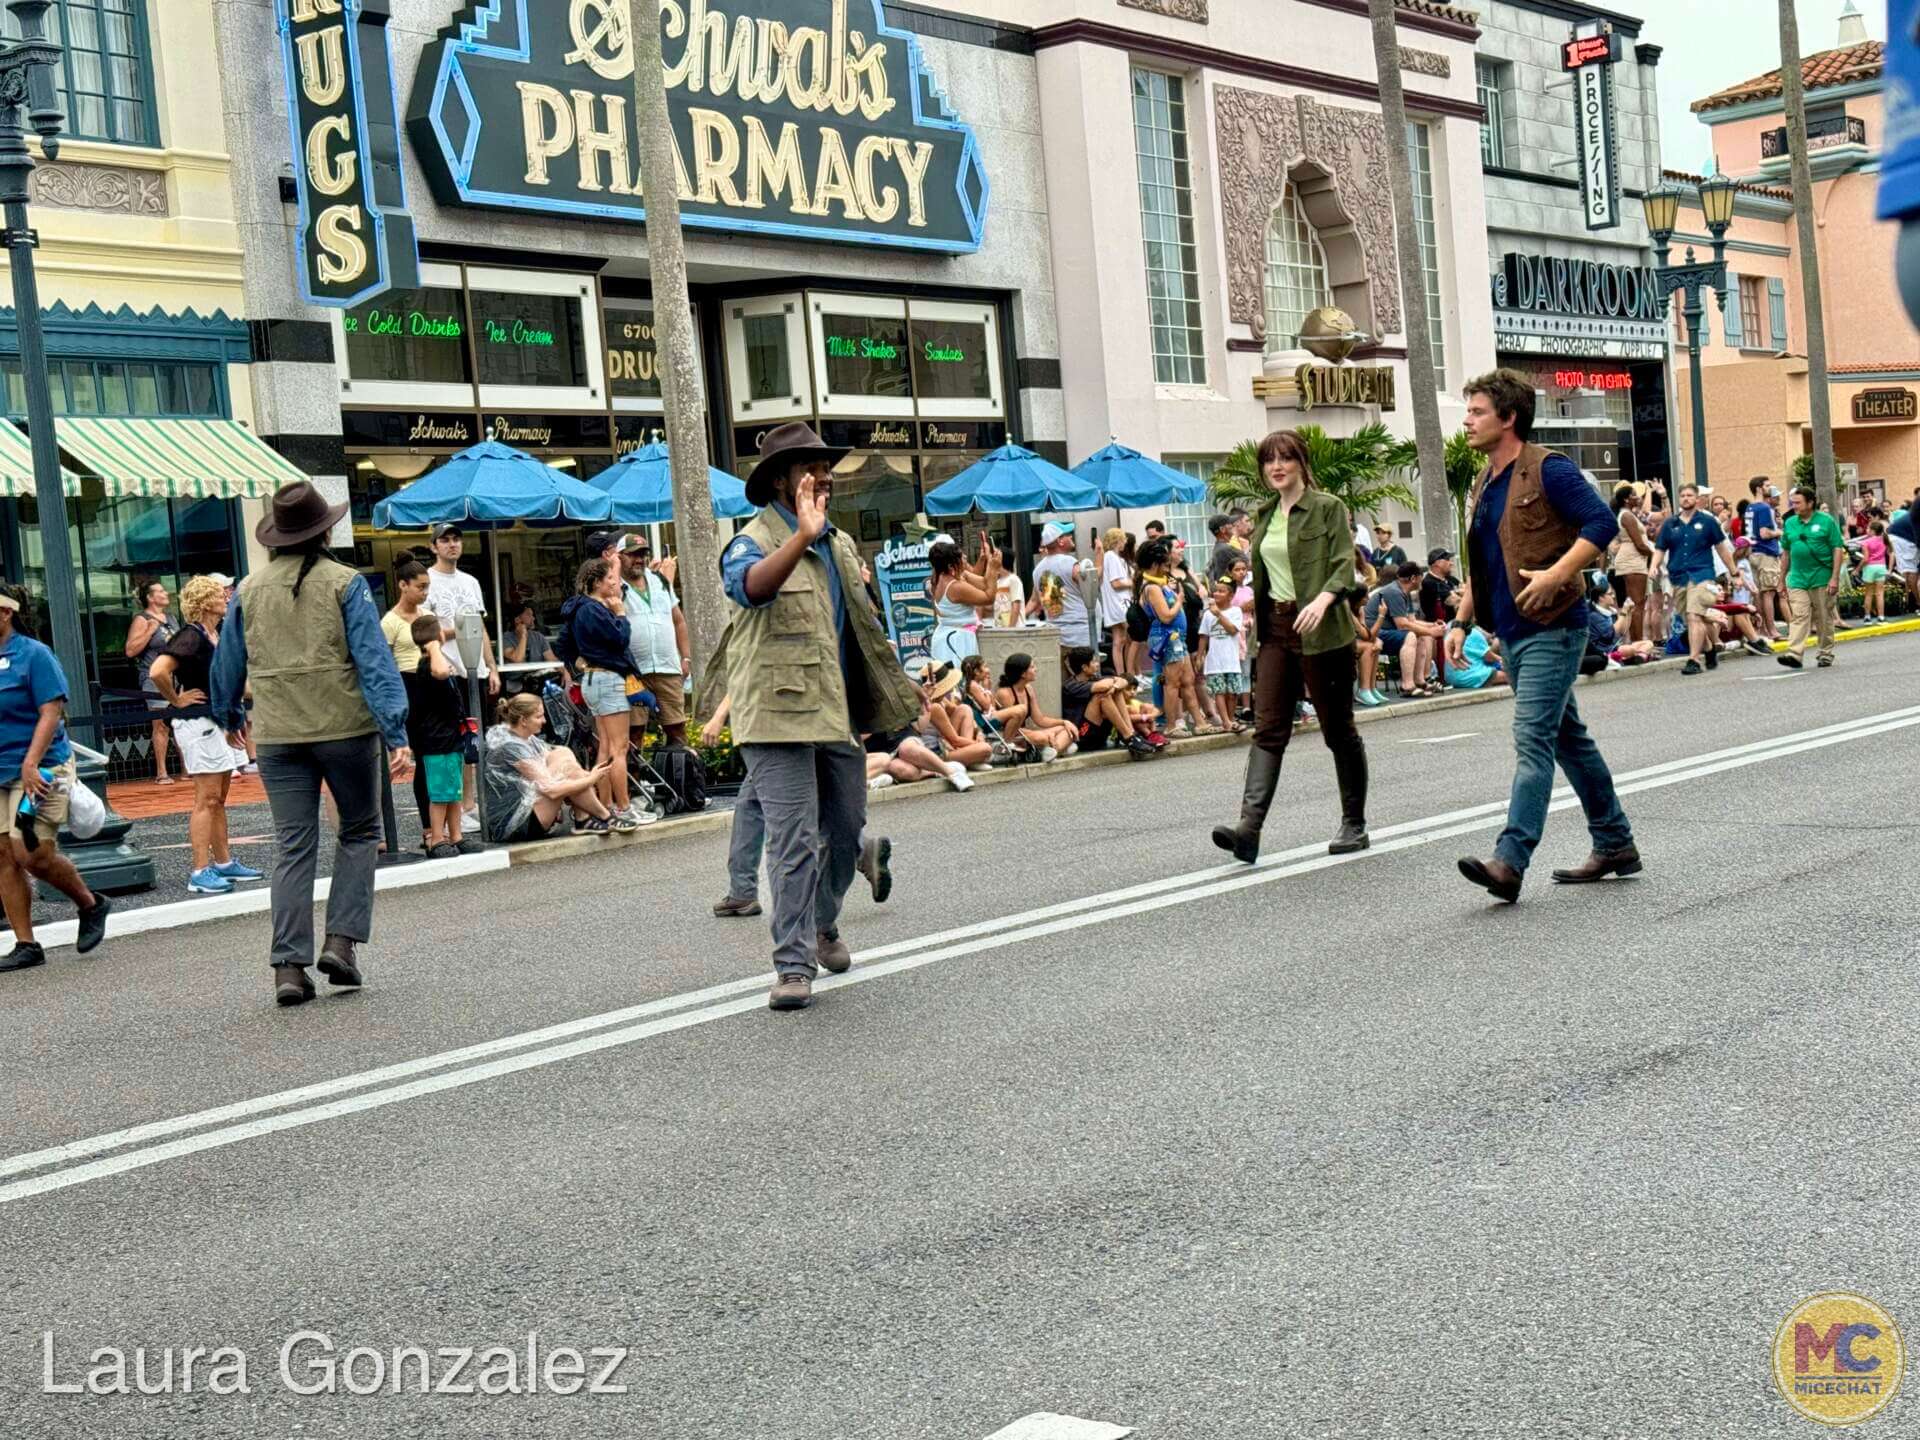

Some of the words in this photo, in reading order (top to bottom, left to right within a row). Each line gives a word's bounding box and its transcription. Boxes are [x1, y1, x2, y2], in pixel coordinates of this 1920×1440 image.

[565, 0, 895, 120] Schwab's
[1585, 72, 1606, 216] PROCESSING
[1514, 252, 1663, 320] DARKROOM
[368, 310, 403, 335] Cold
[409, 311, 461, 338] Drinks
[486, 320, 507, 342] Ice
[512, 319, 554, 345] Cream
[827, 336, 857, 358] Milk
[860, 337, 897, 359] Shakes
[924, 341, 965, 362] Sundaes
[1541, 335, 1608, 357] PHOTOGRAPHIC
[1555, 371, 1584, 387] PHOTO
[1589, 372, 1633, 388] FINISHING
[1856, 396, 1914, 418] THEATER
[408, 415, 469, 441] Schwab's
[492, 416, 552, 445] Pharmacy
[925, 423, 968, 446] Pharmacy
